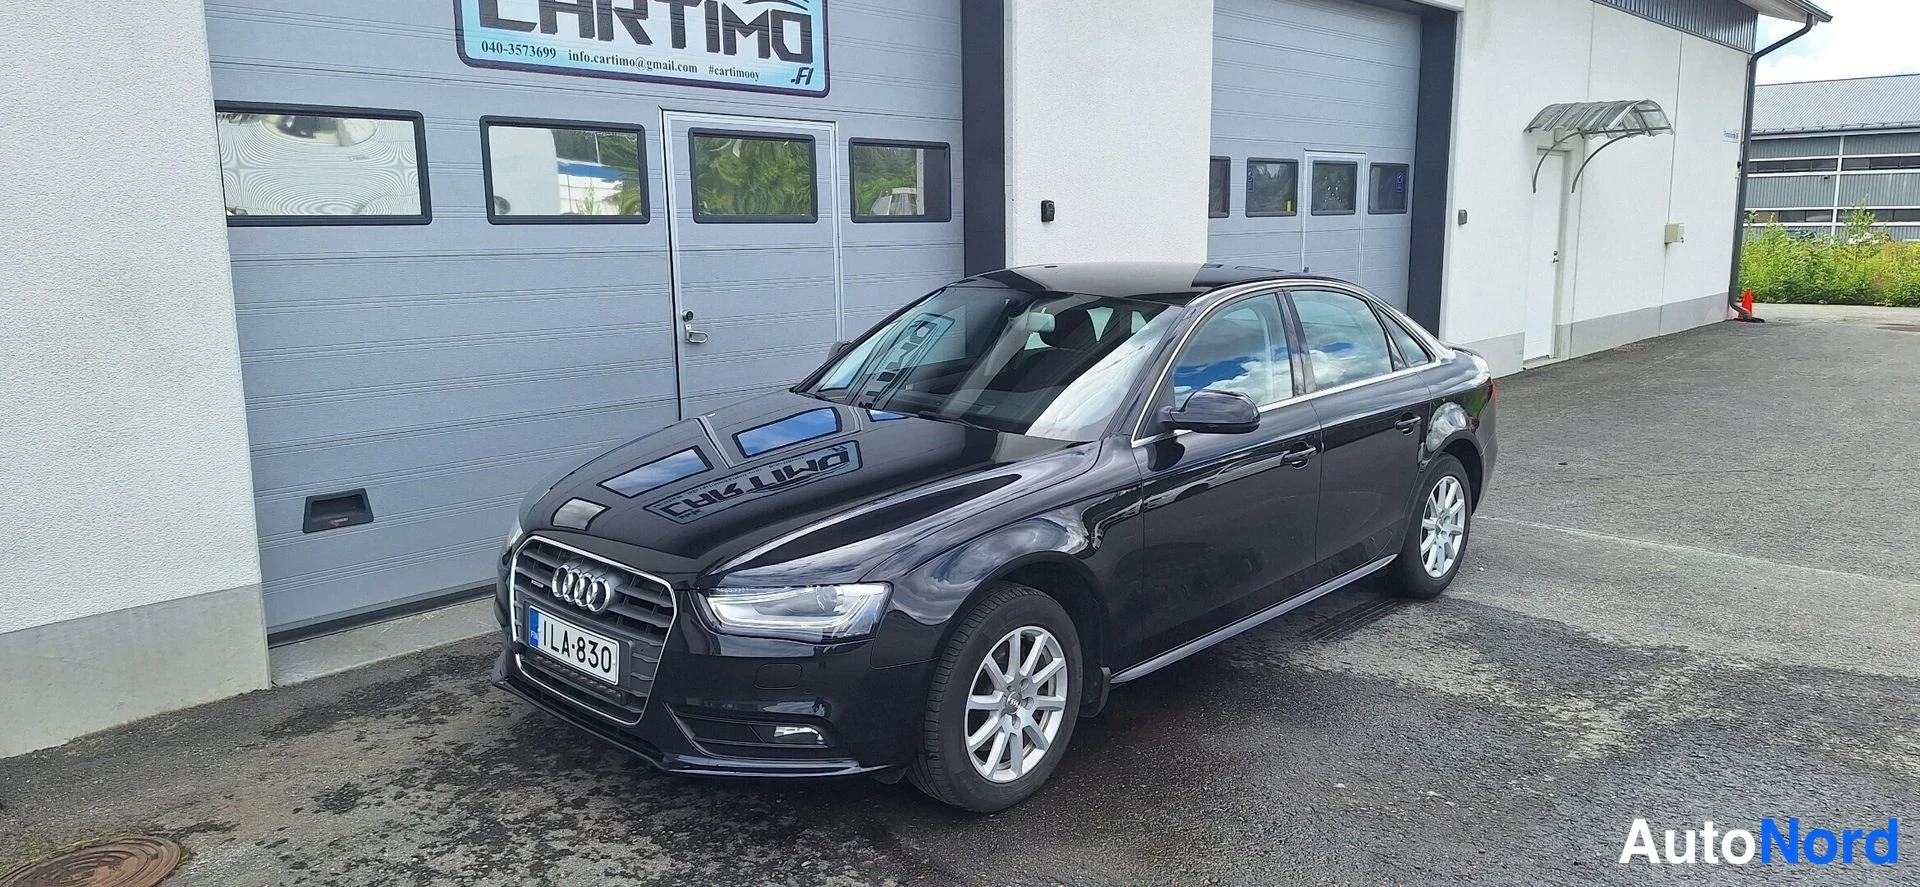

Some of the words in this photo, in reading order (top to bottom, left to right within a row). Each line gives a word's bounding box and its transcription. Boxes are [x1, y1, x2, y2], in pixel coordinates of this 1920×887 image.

[481, 40, 557, 59] 040-3573699
[568, 50, 698, 73] info.cartimo@gmail.com
[708, 65, 761, 82] #cartimooy
[790, 67, 814, 85] .FI
